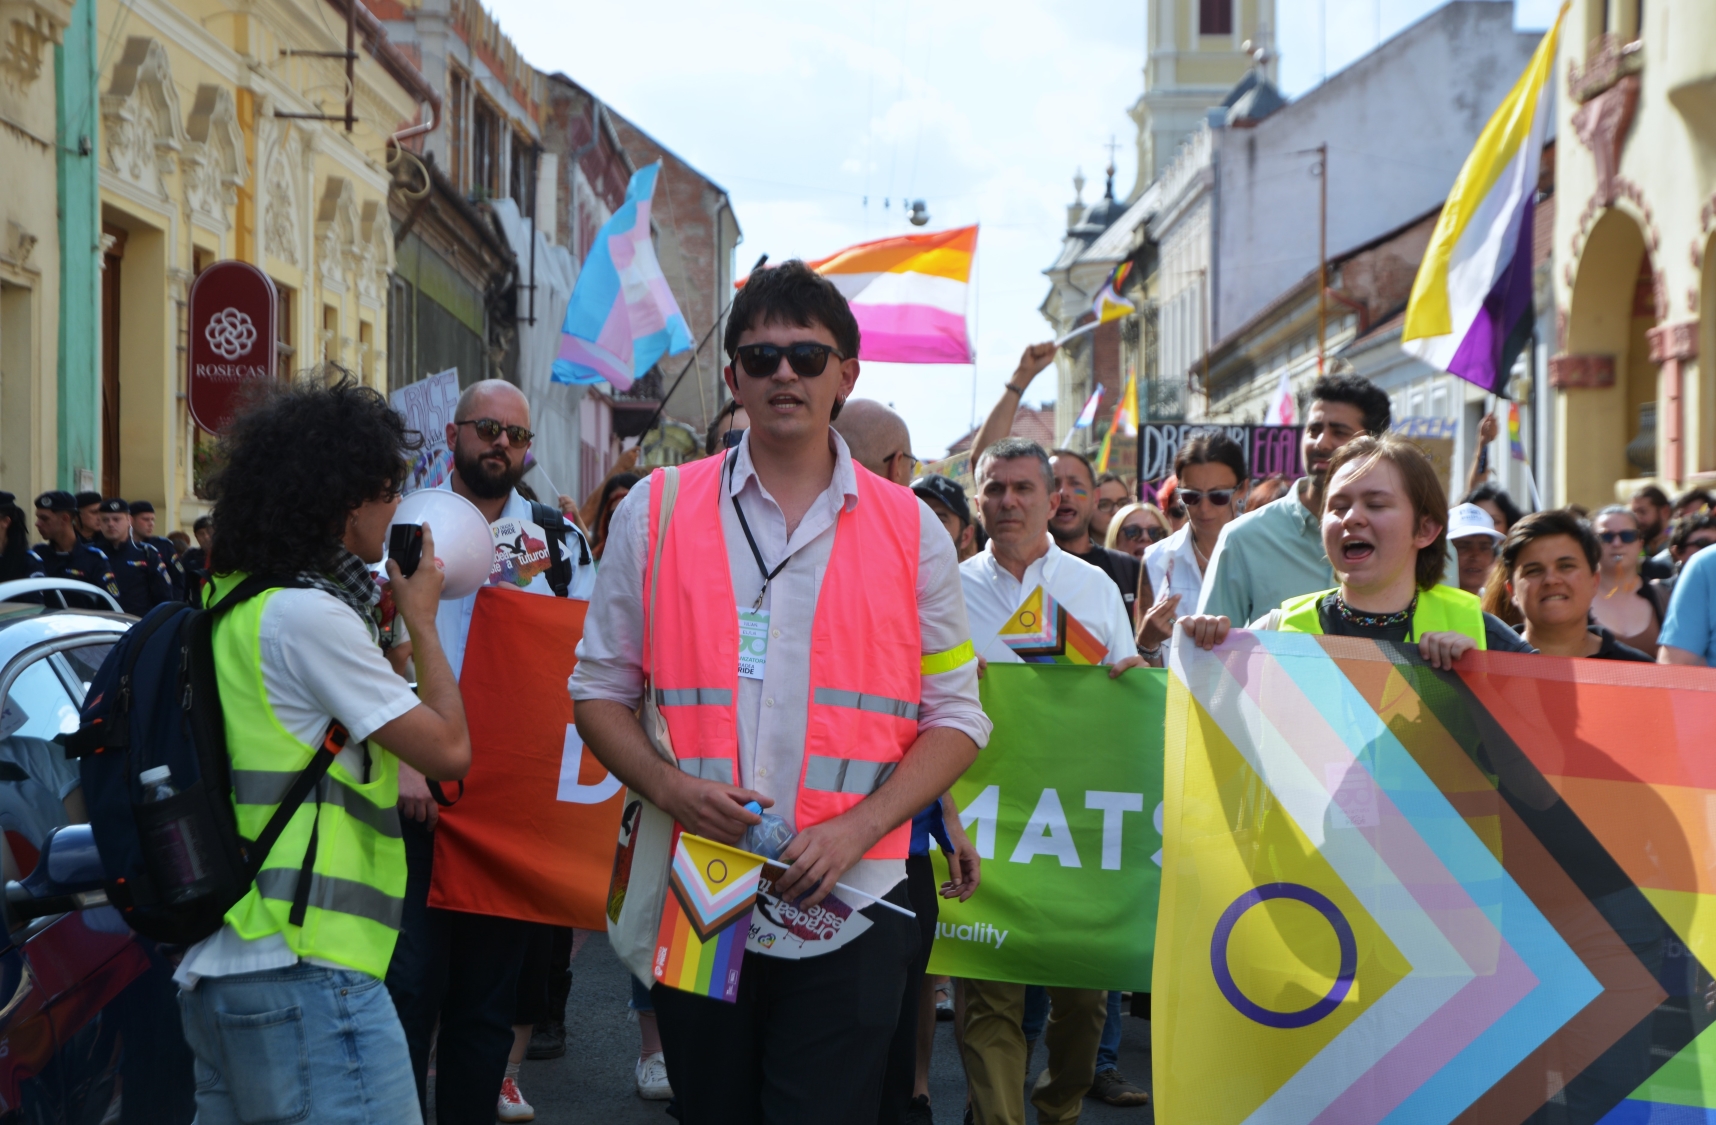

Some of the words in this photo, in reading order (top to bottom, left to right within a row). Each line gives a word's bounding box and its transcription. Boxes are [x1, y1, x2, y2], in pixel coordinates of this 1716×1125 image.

[196, 364, 266, 378] ROSECAS
[1253, 428, 1308, 478] EGAL
[738, 667, 755, 675] RIDE
[778, 901, 836, 941] Oradea
